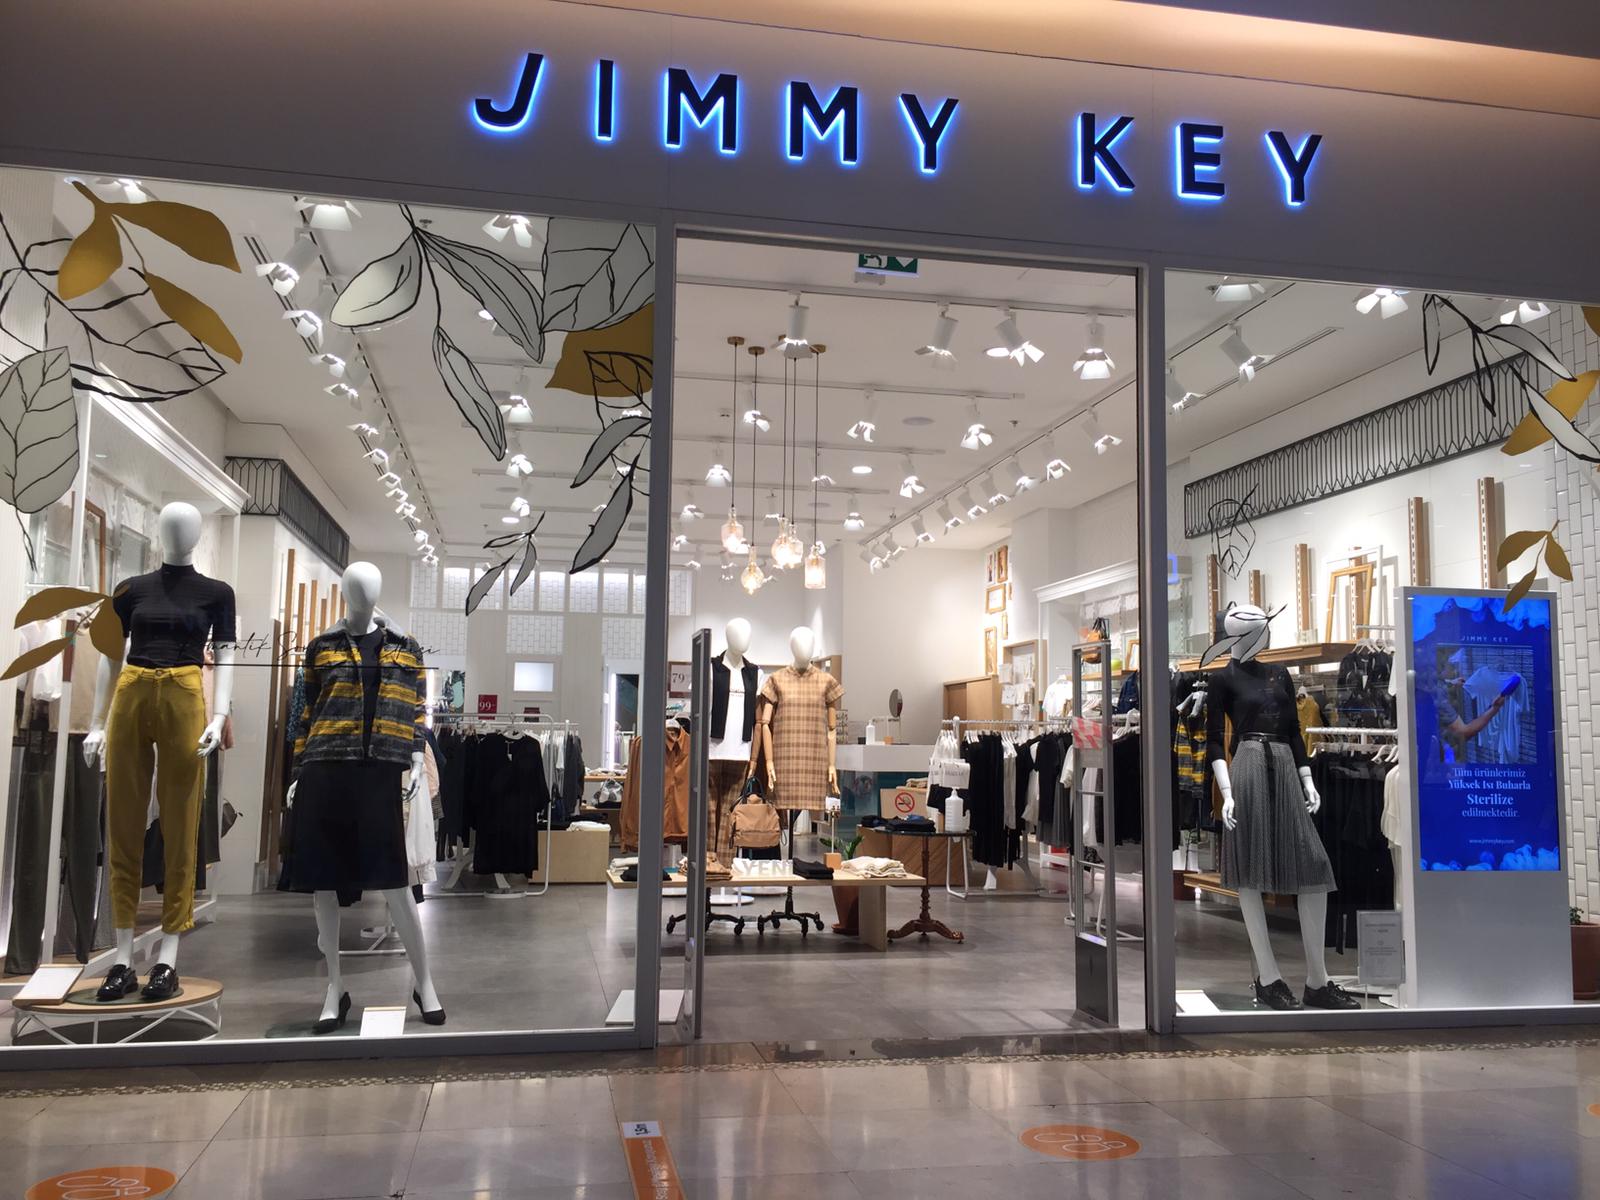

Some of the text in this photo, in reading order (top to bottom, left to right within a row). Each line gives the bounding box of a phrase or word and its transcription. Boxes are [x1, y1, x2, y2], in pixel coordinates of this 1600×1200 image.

[473, 52, 1323, 206] JIMMY KEY
[1453, 767, 1527, 779] Tüm ürünlerimiz
[1448, 779, 1481, 790] Yüksek
[1496, 780, 1531, 791] Buharla
[1466, 793, 1514, 806] Sterilize
